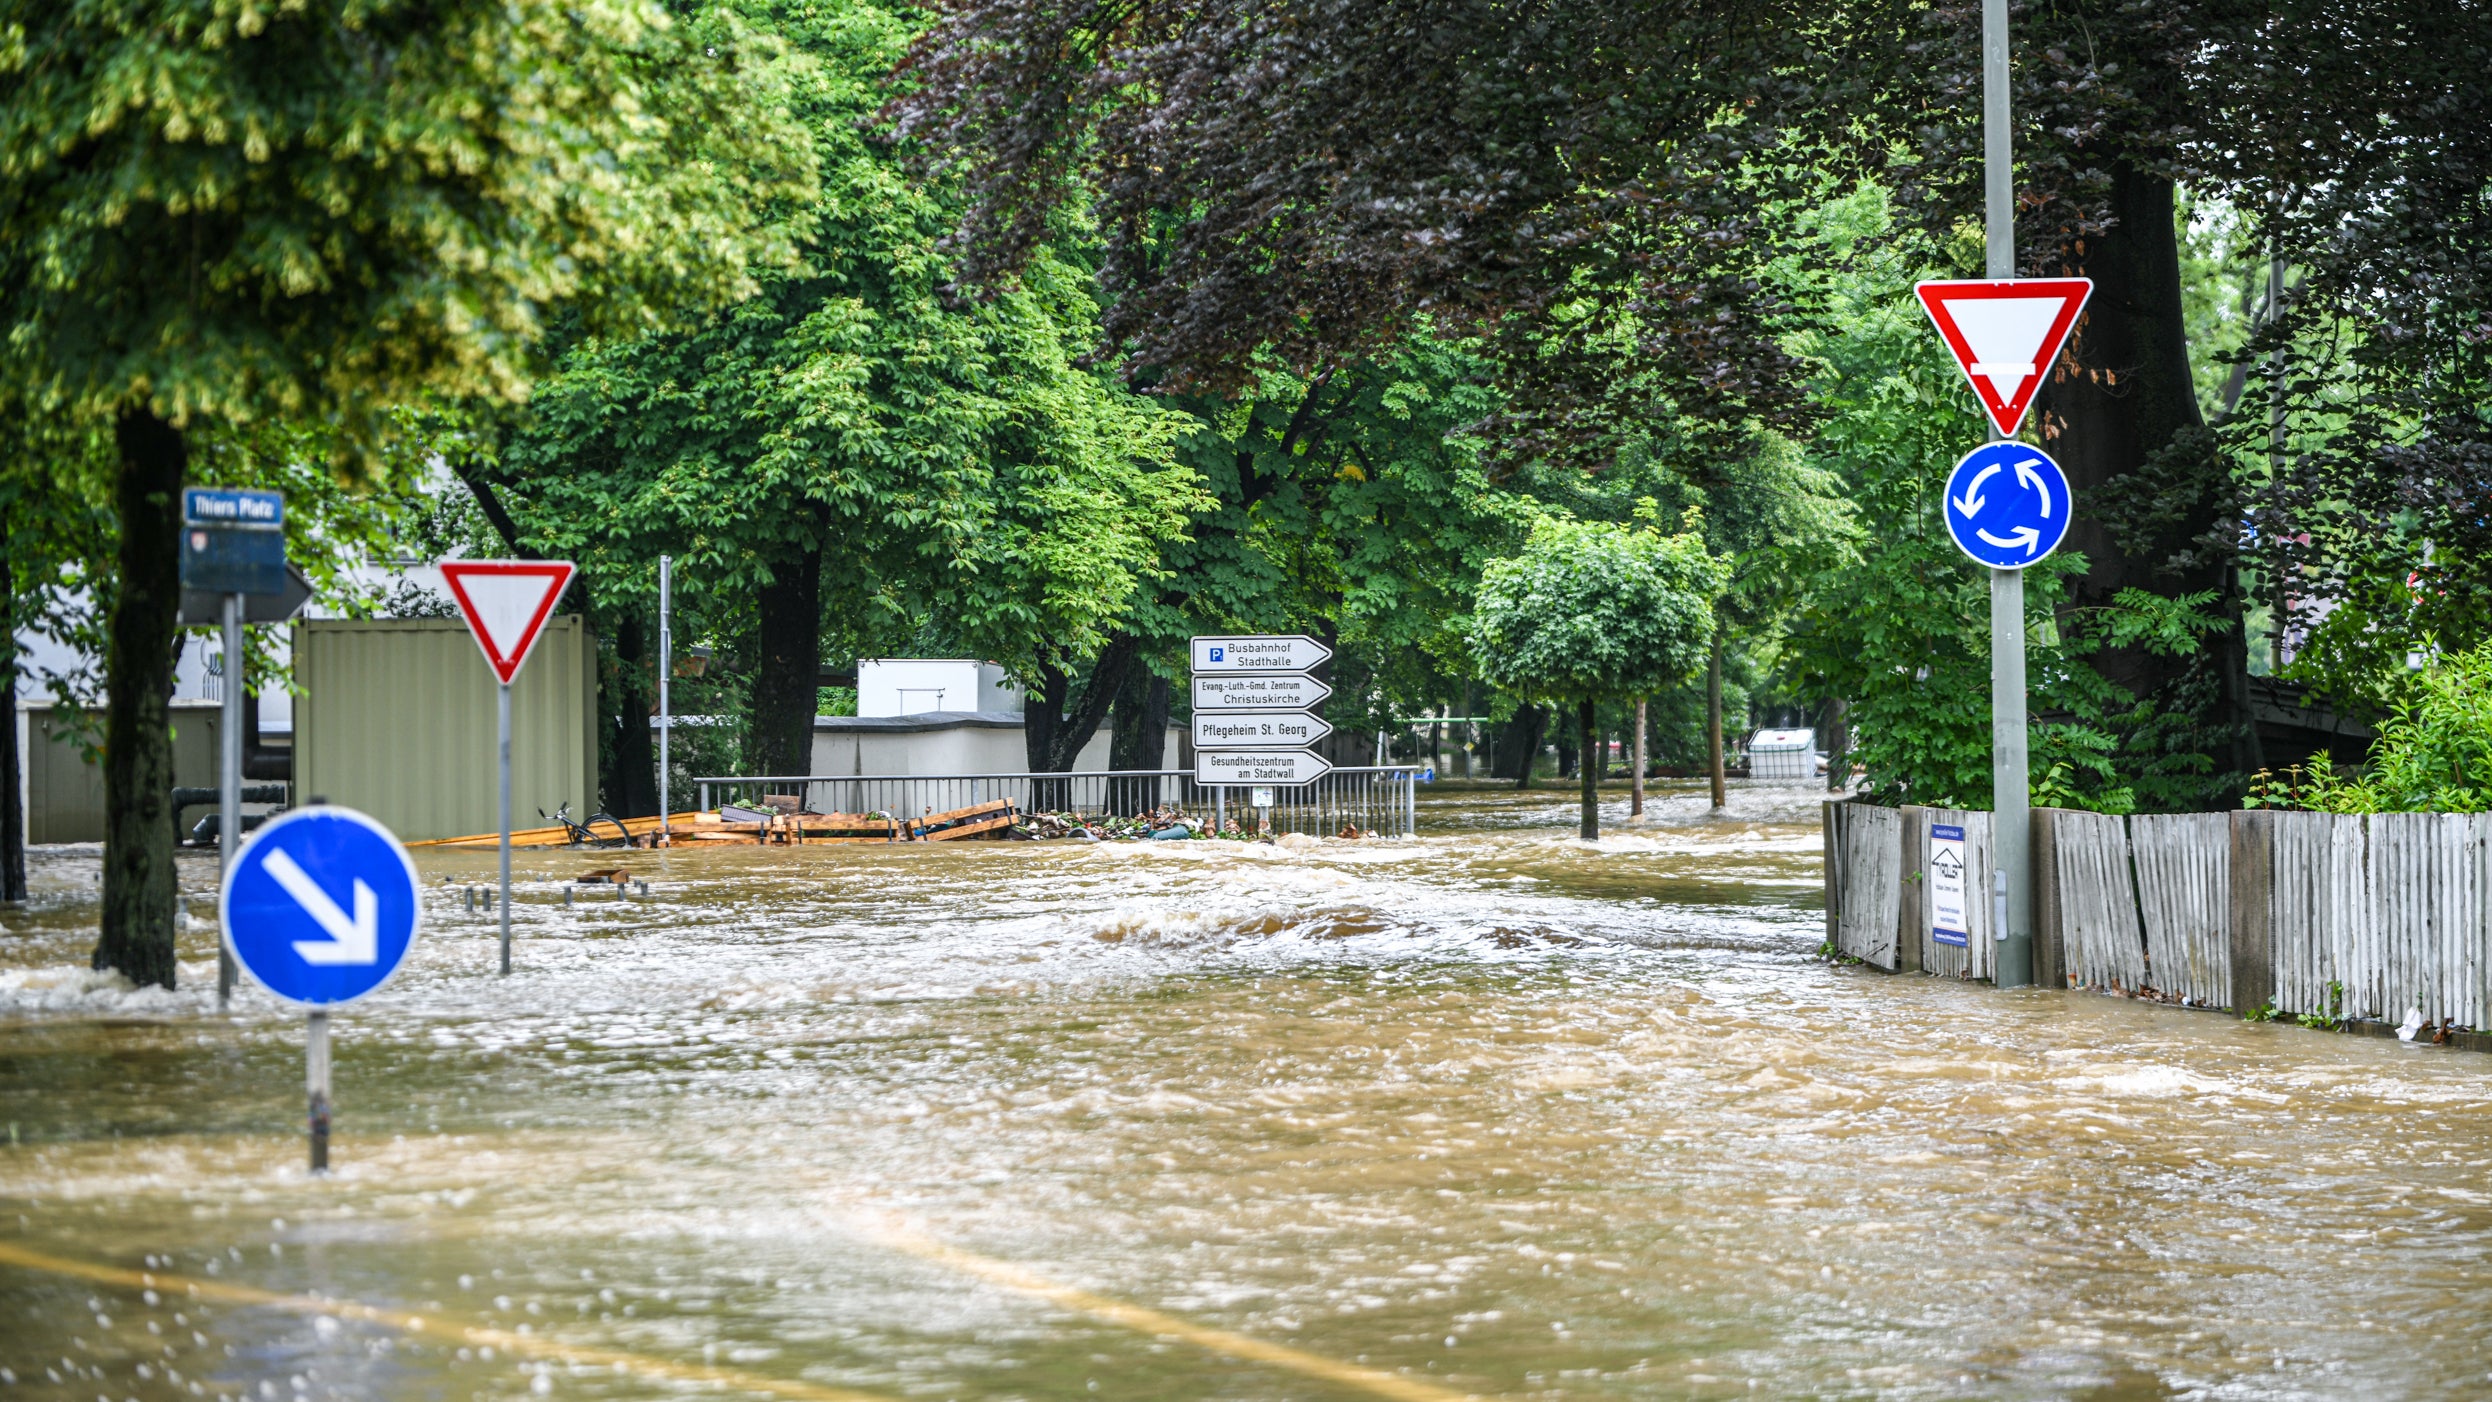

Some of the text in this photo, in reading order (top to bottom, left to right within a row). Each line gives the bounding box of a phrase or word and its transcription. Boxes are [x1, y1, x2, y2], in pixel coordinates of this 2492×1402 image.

[1228, 643, 1291, 653] Busbahnhof
[1212, 650, 1220, 660] P
[1238, 657, 1291, 666] Stadthalle
[1202, 681, 1300, 692] Evang.-Luth.-Gmd. Zentrum
[1224, 694, 1300, 704] Christuskirche
[1203, 724, 1307, 738] Pflegeheim St. Georg
[1211, 756, 1294, 766] Gesundheitszentrum
[1238, 769, 1294, 778] am Stadtwall
